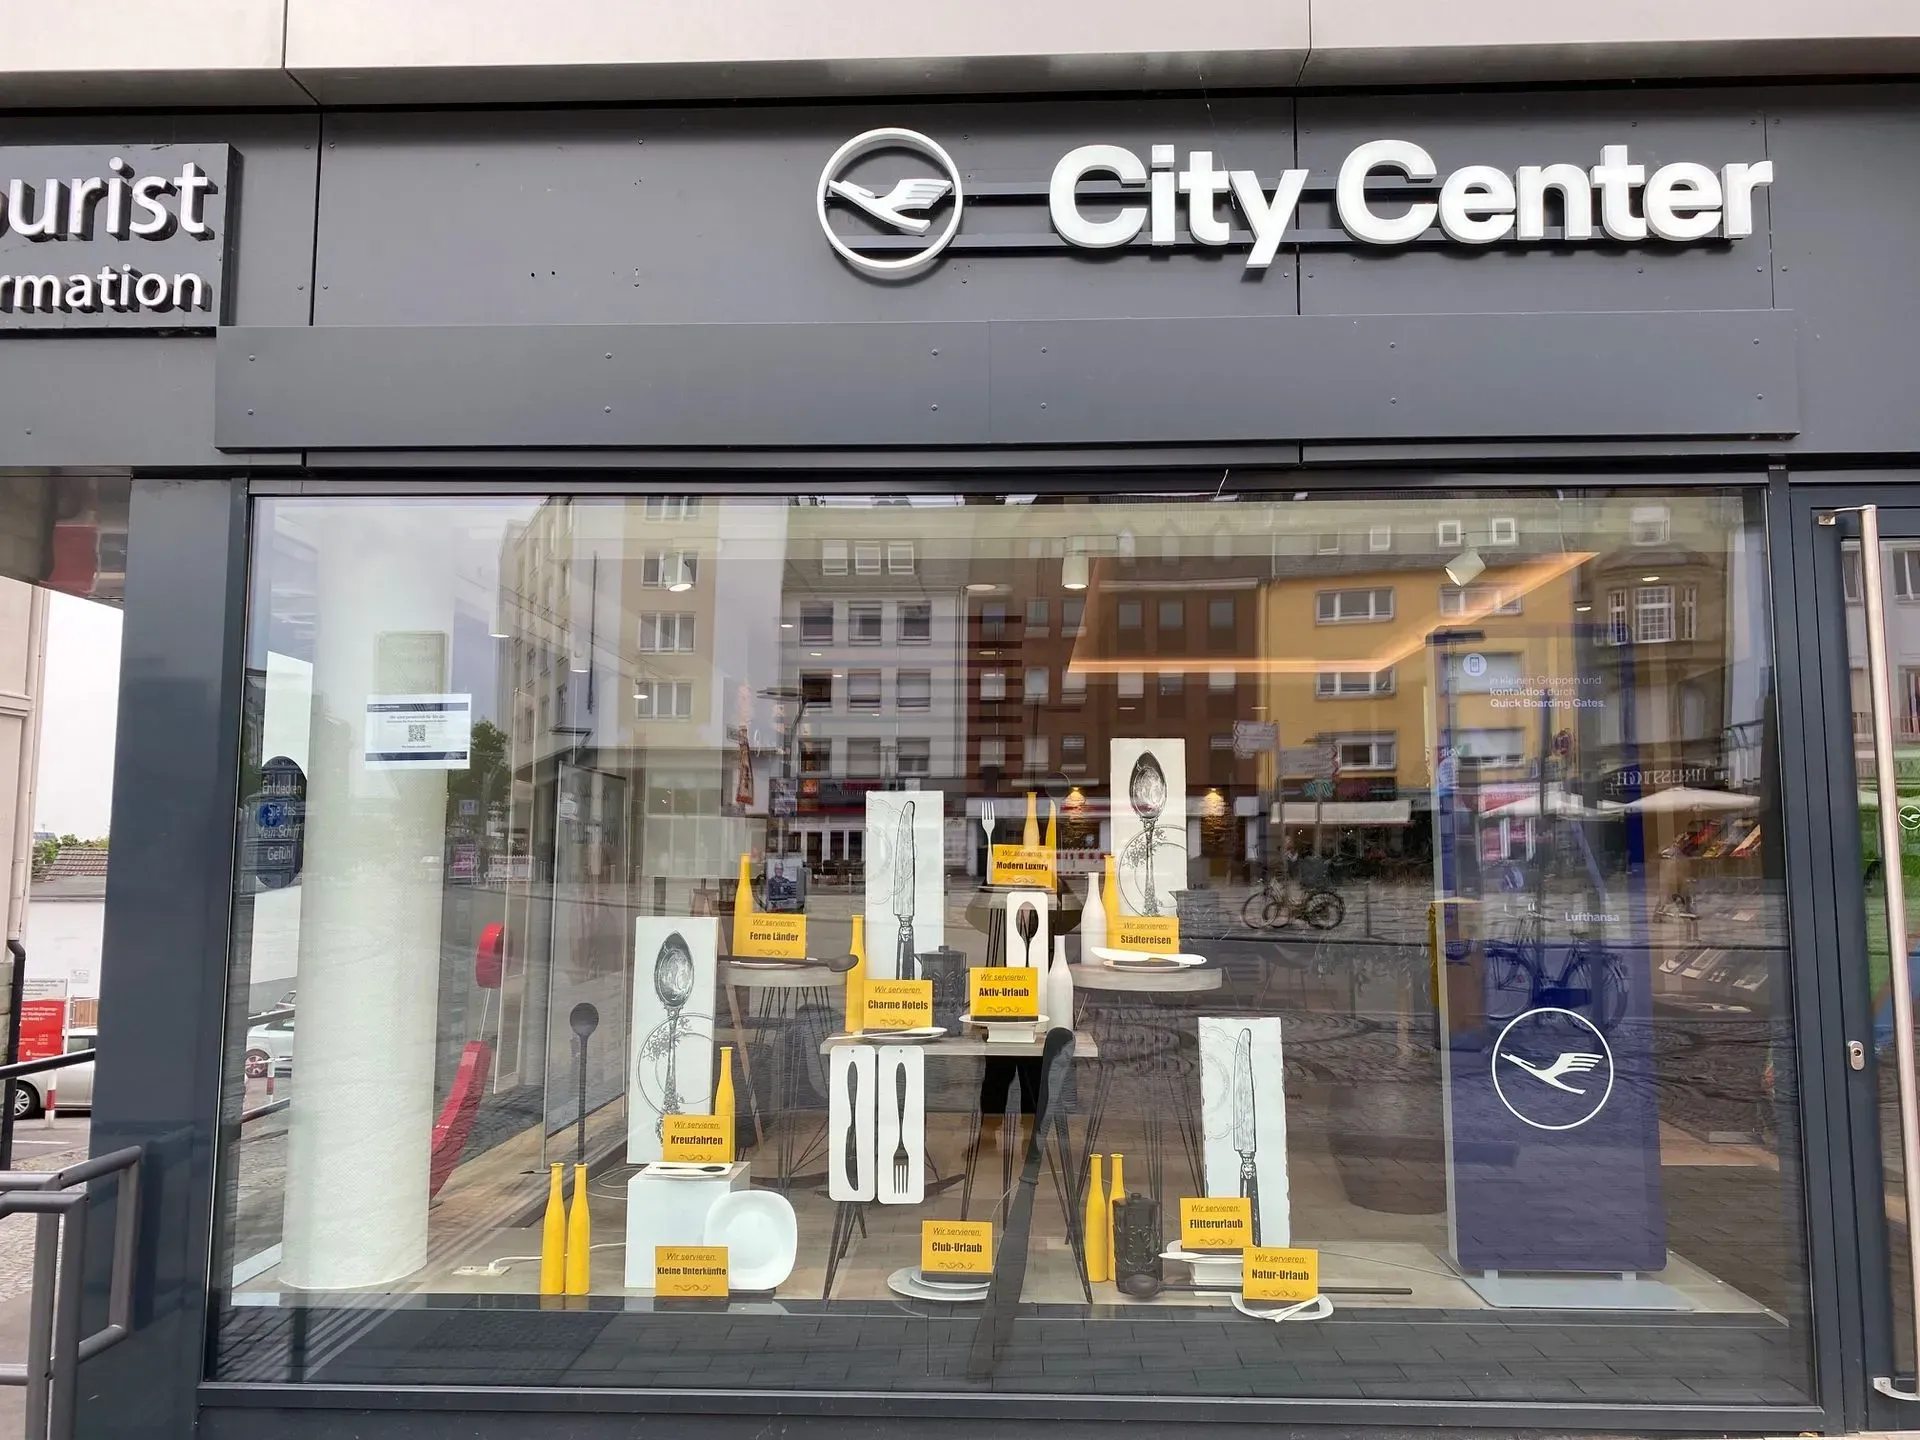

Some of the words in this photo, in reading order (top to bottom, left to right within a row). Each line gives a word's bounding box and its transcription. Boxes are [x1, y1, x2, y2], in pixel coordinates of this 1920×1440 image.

[0, 156, 208, 236] urist
[1049, 144, 1310, 268] City
[1336, 139, 1774, 245] Center
[1536, 675, 1580, 687] Gruppen
[1582, 675, 1602, 685] und
[1489, 687, 1546, 696] kontaktlos
[1547, 687, 1576, 696] durch
[1490, 698, 1521, 708] Quick
[1523, 698, 1571, 710] Boarding
[283, 802, 297, 816] das
[996, 862, 1024, 870] Modern
[1025, 862, 1049, 871] Luxury
[1565, 911, 1620, 922] Lufthansa
[750, 931, 772, 941] Ferne
[773, 932, 799, 942] Länder
[1120, 934, 1172, 945] Städtereisen
[979, 987, 1029, 997] Aktiv-Urlaub
[868, 1000, 901, 1010] Charme
[902, 1000, 929, 1010] Hotels
[670, 1135, 723, 1145] Kreuzfahrten
[1190, 1219, 1243, 1229] Flitterurlaub
[931, 1242, 983, 1253] Club-Urlaub
[657, 1267, 682, 1275] Kleine
[682, 1267, 727, 1276] Unterkünfte
[1251, 1269, 1309, 1281] Natur-Urlaub
